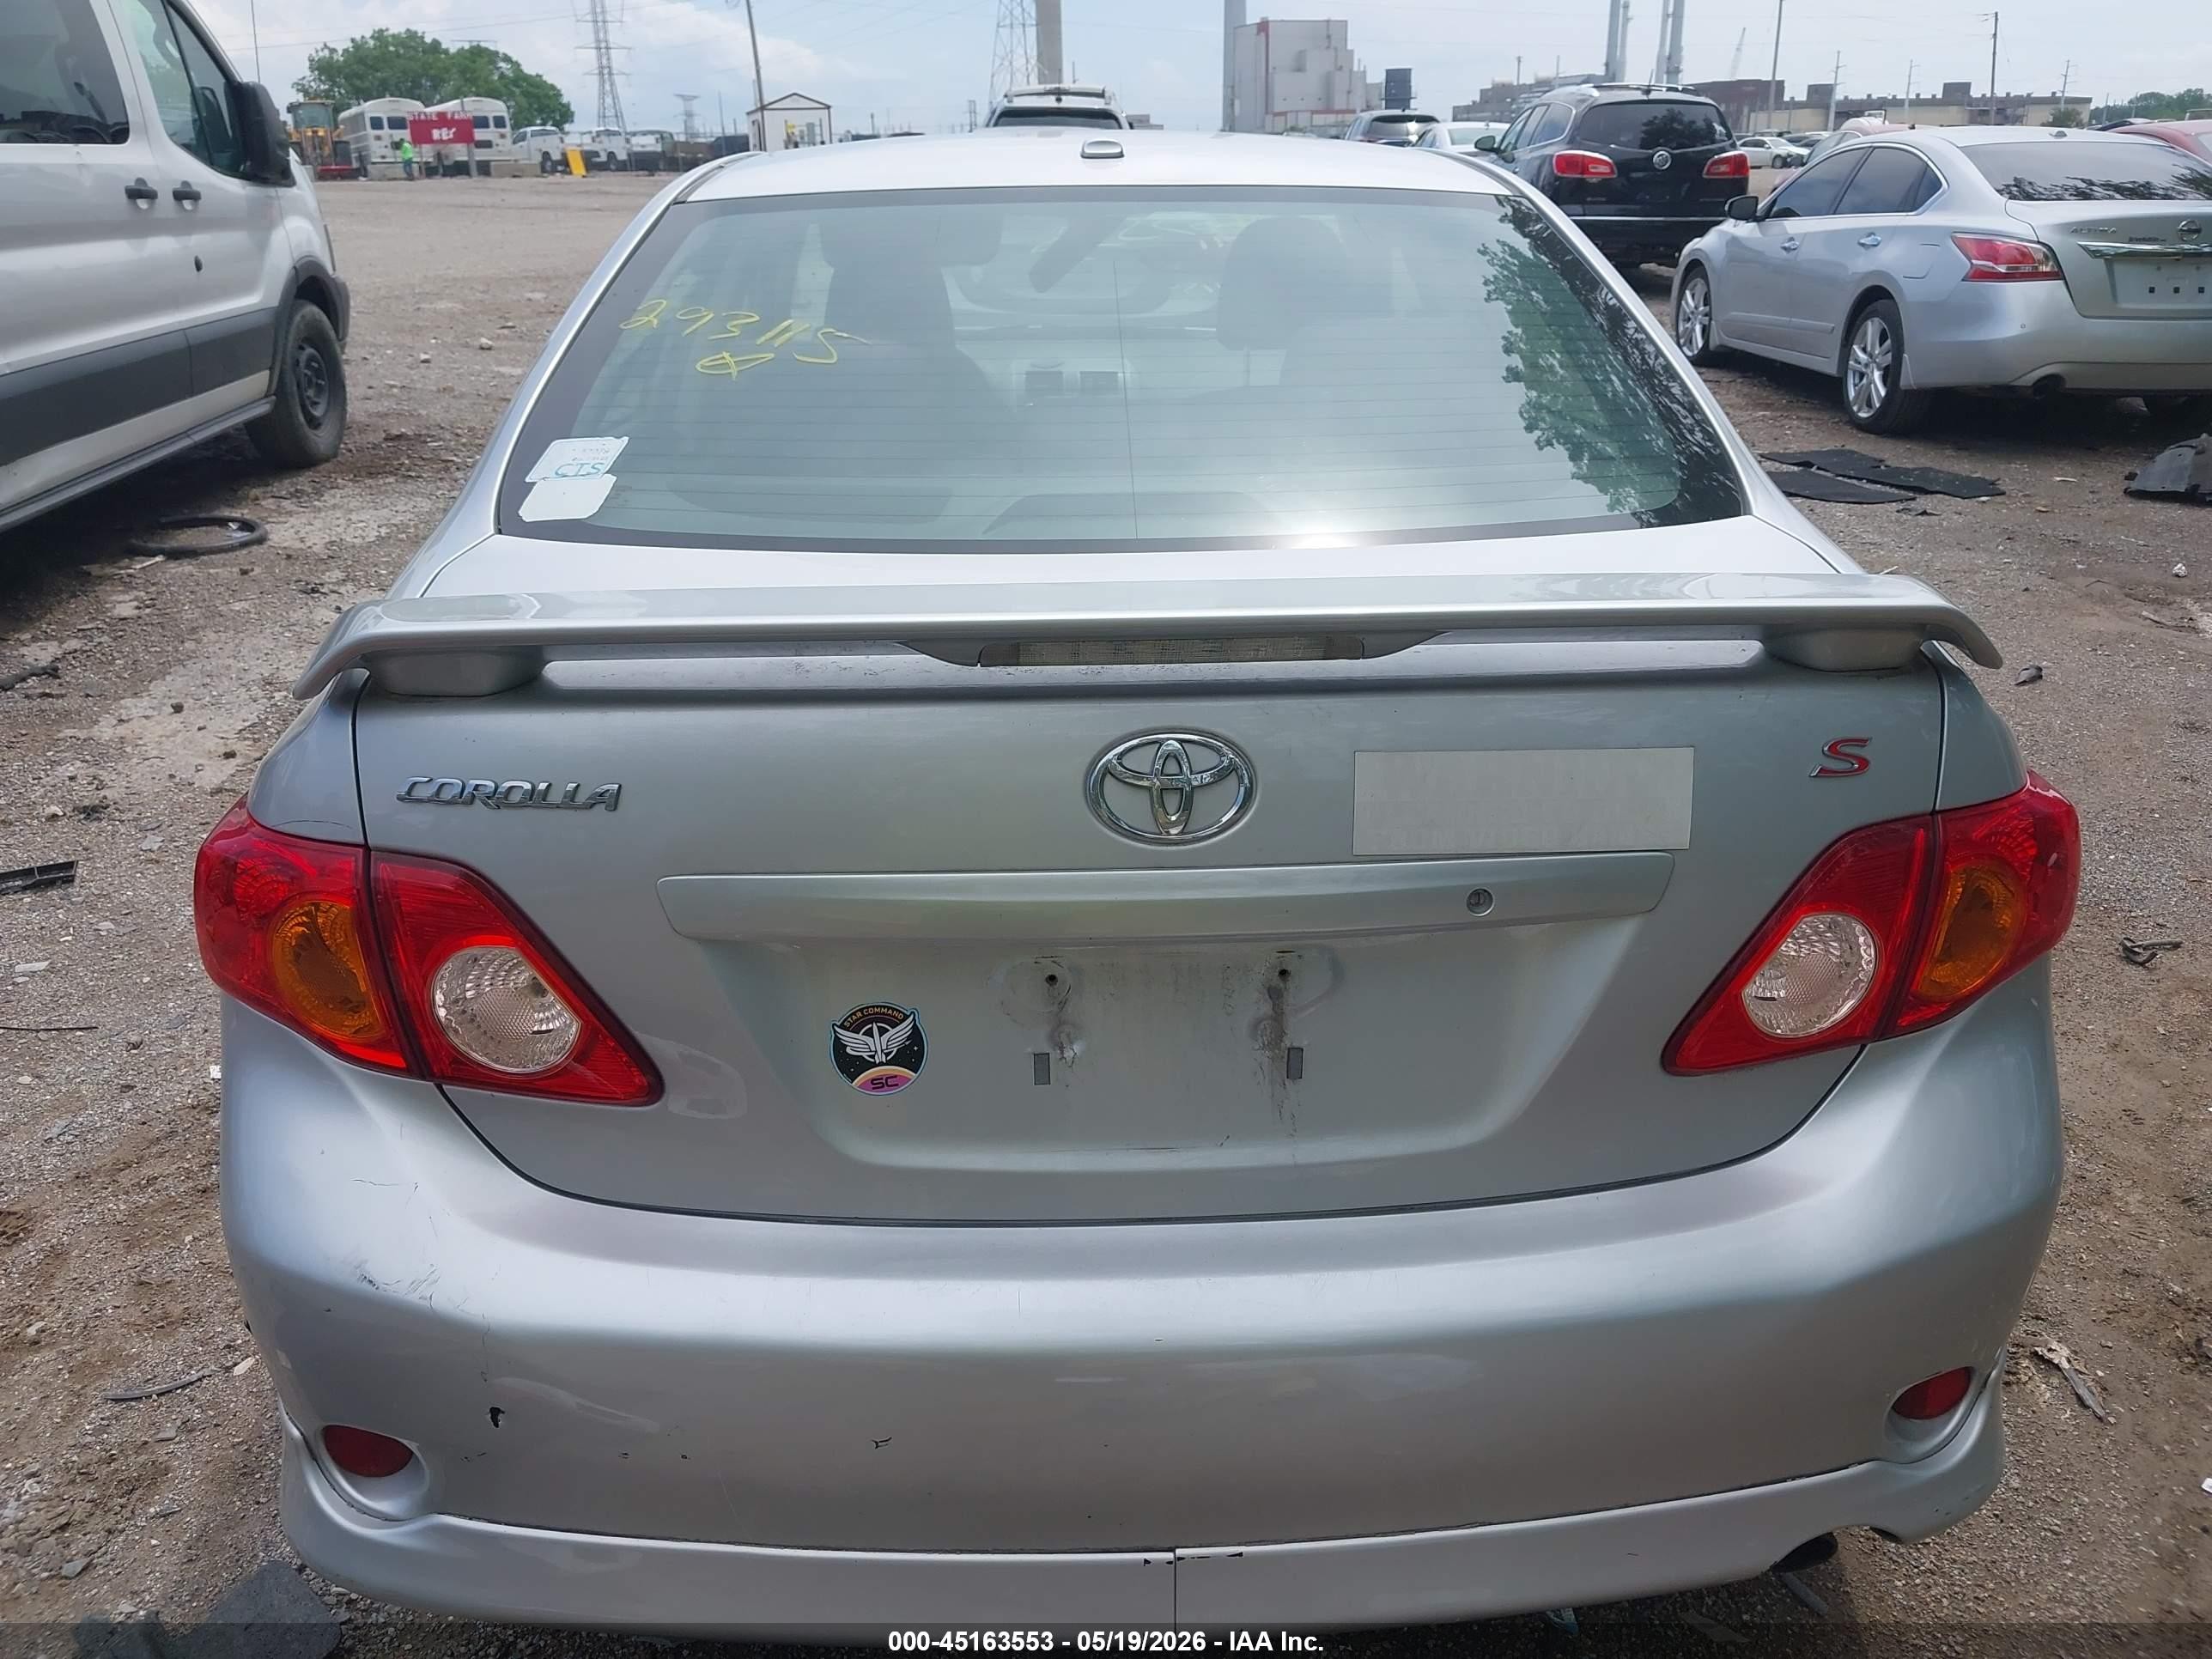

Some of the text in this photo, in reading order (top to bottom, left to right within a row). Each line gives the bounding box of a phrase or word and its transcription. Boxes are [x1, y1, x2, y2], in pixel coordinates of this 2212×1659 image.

[407, 112, 439, 121] STATE
[1808, 737, 1871, 778] S
[396, 776, 623, 811] COROLLA
[844, 1006, 904, 1028] STAR COMMAND
[870, 1075, 899, 1091] SC
